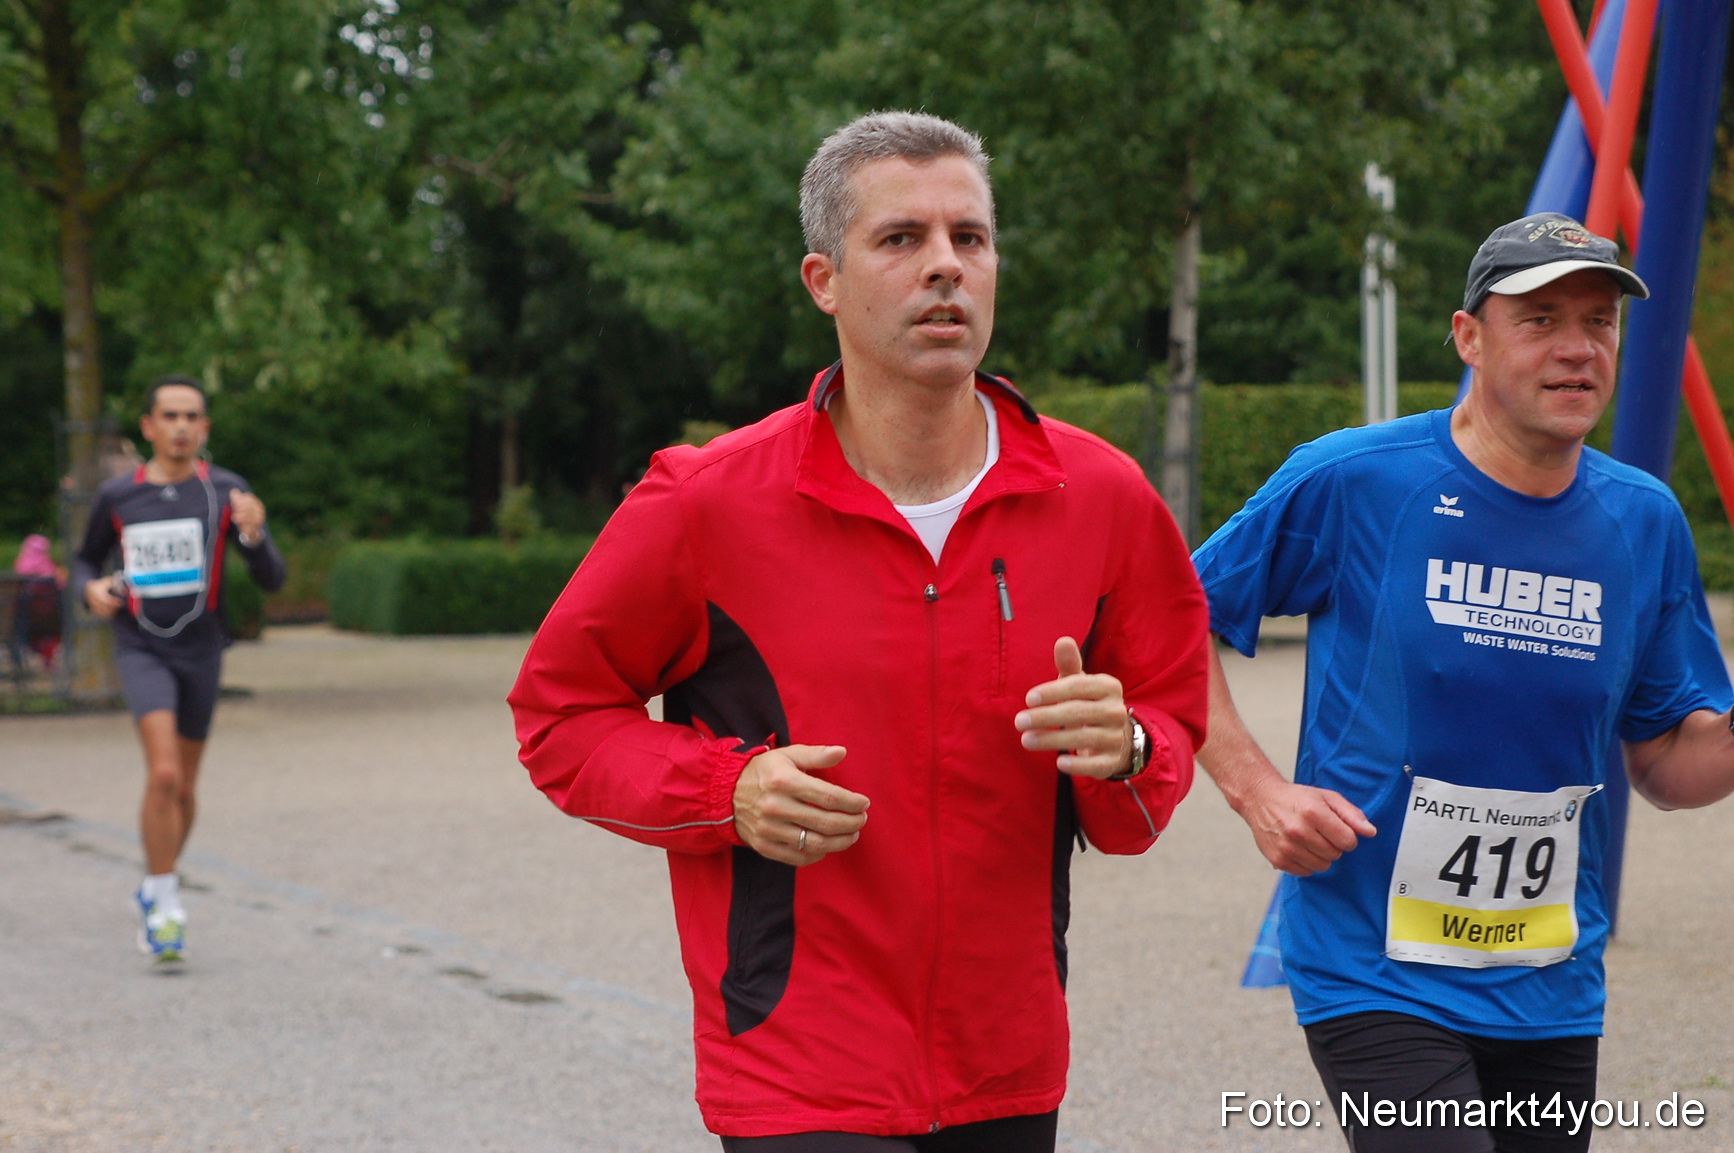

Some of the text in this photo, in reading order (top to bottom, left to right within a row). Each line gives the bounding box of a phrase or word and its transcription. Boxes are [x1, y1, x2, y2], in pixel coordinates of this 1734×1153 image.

[1433, 506, 1464, 517] erima
[1425, 558, 1602, 622] HUBER
[1465, 609, 1595, 641] TECHNOLOGY
[1463, 631, 1596, 662] WASTE WATER Solutions
[1413, 796, 1480, 823] PARTL
[1438, 835, 1556, 900] 419
[1399, 883, 1407, 894] B
[1442, 913, 1526, 944] Werner
